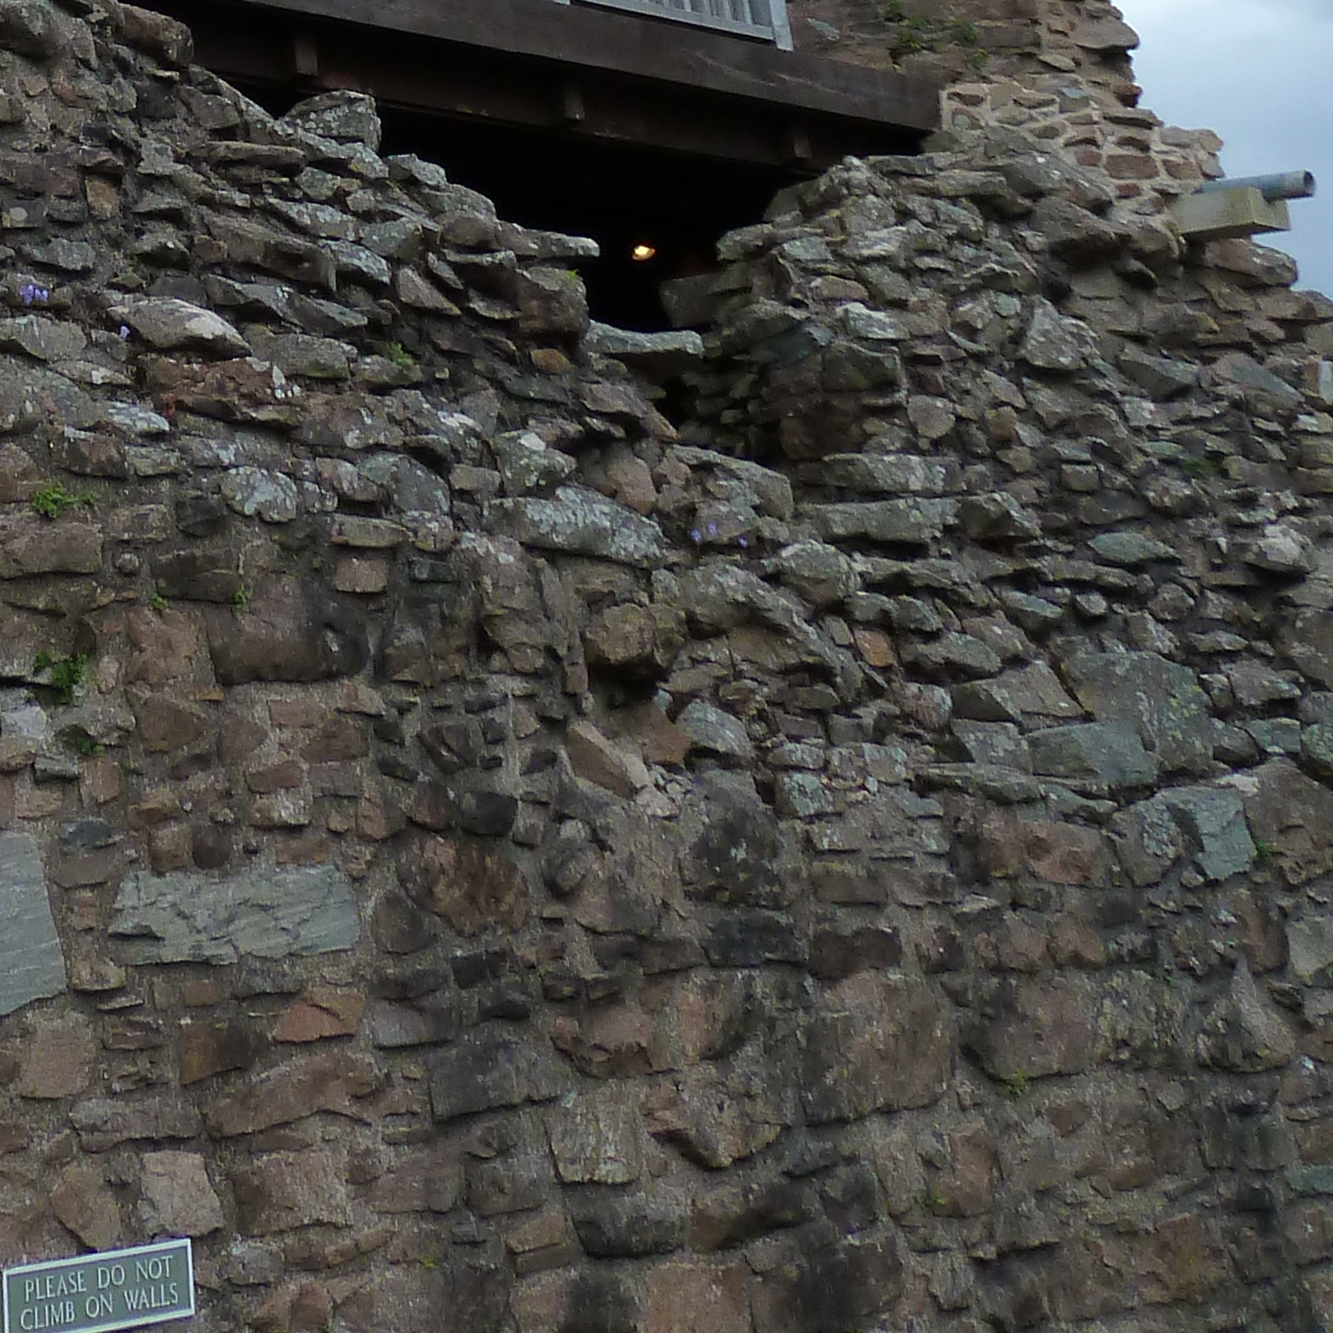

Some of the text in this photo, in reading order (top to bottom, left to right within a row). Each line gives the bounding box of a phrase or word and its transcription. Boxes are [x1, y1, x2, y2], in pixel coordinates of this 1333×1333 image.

[25, 1255, 173, 1302] PLEASE DO NOT
[20, 1283, 178, 1330] CLIMB ON WALLS
